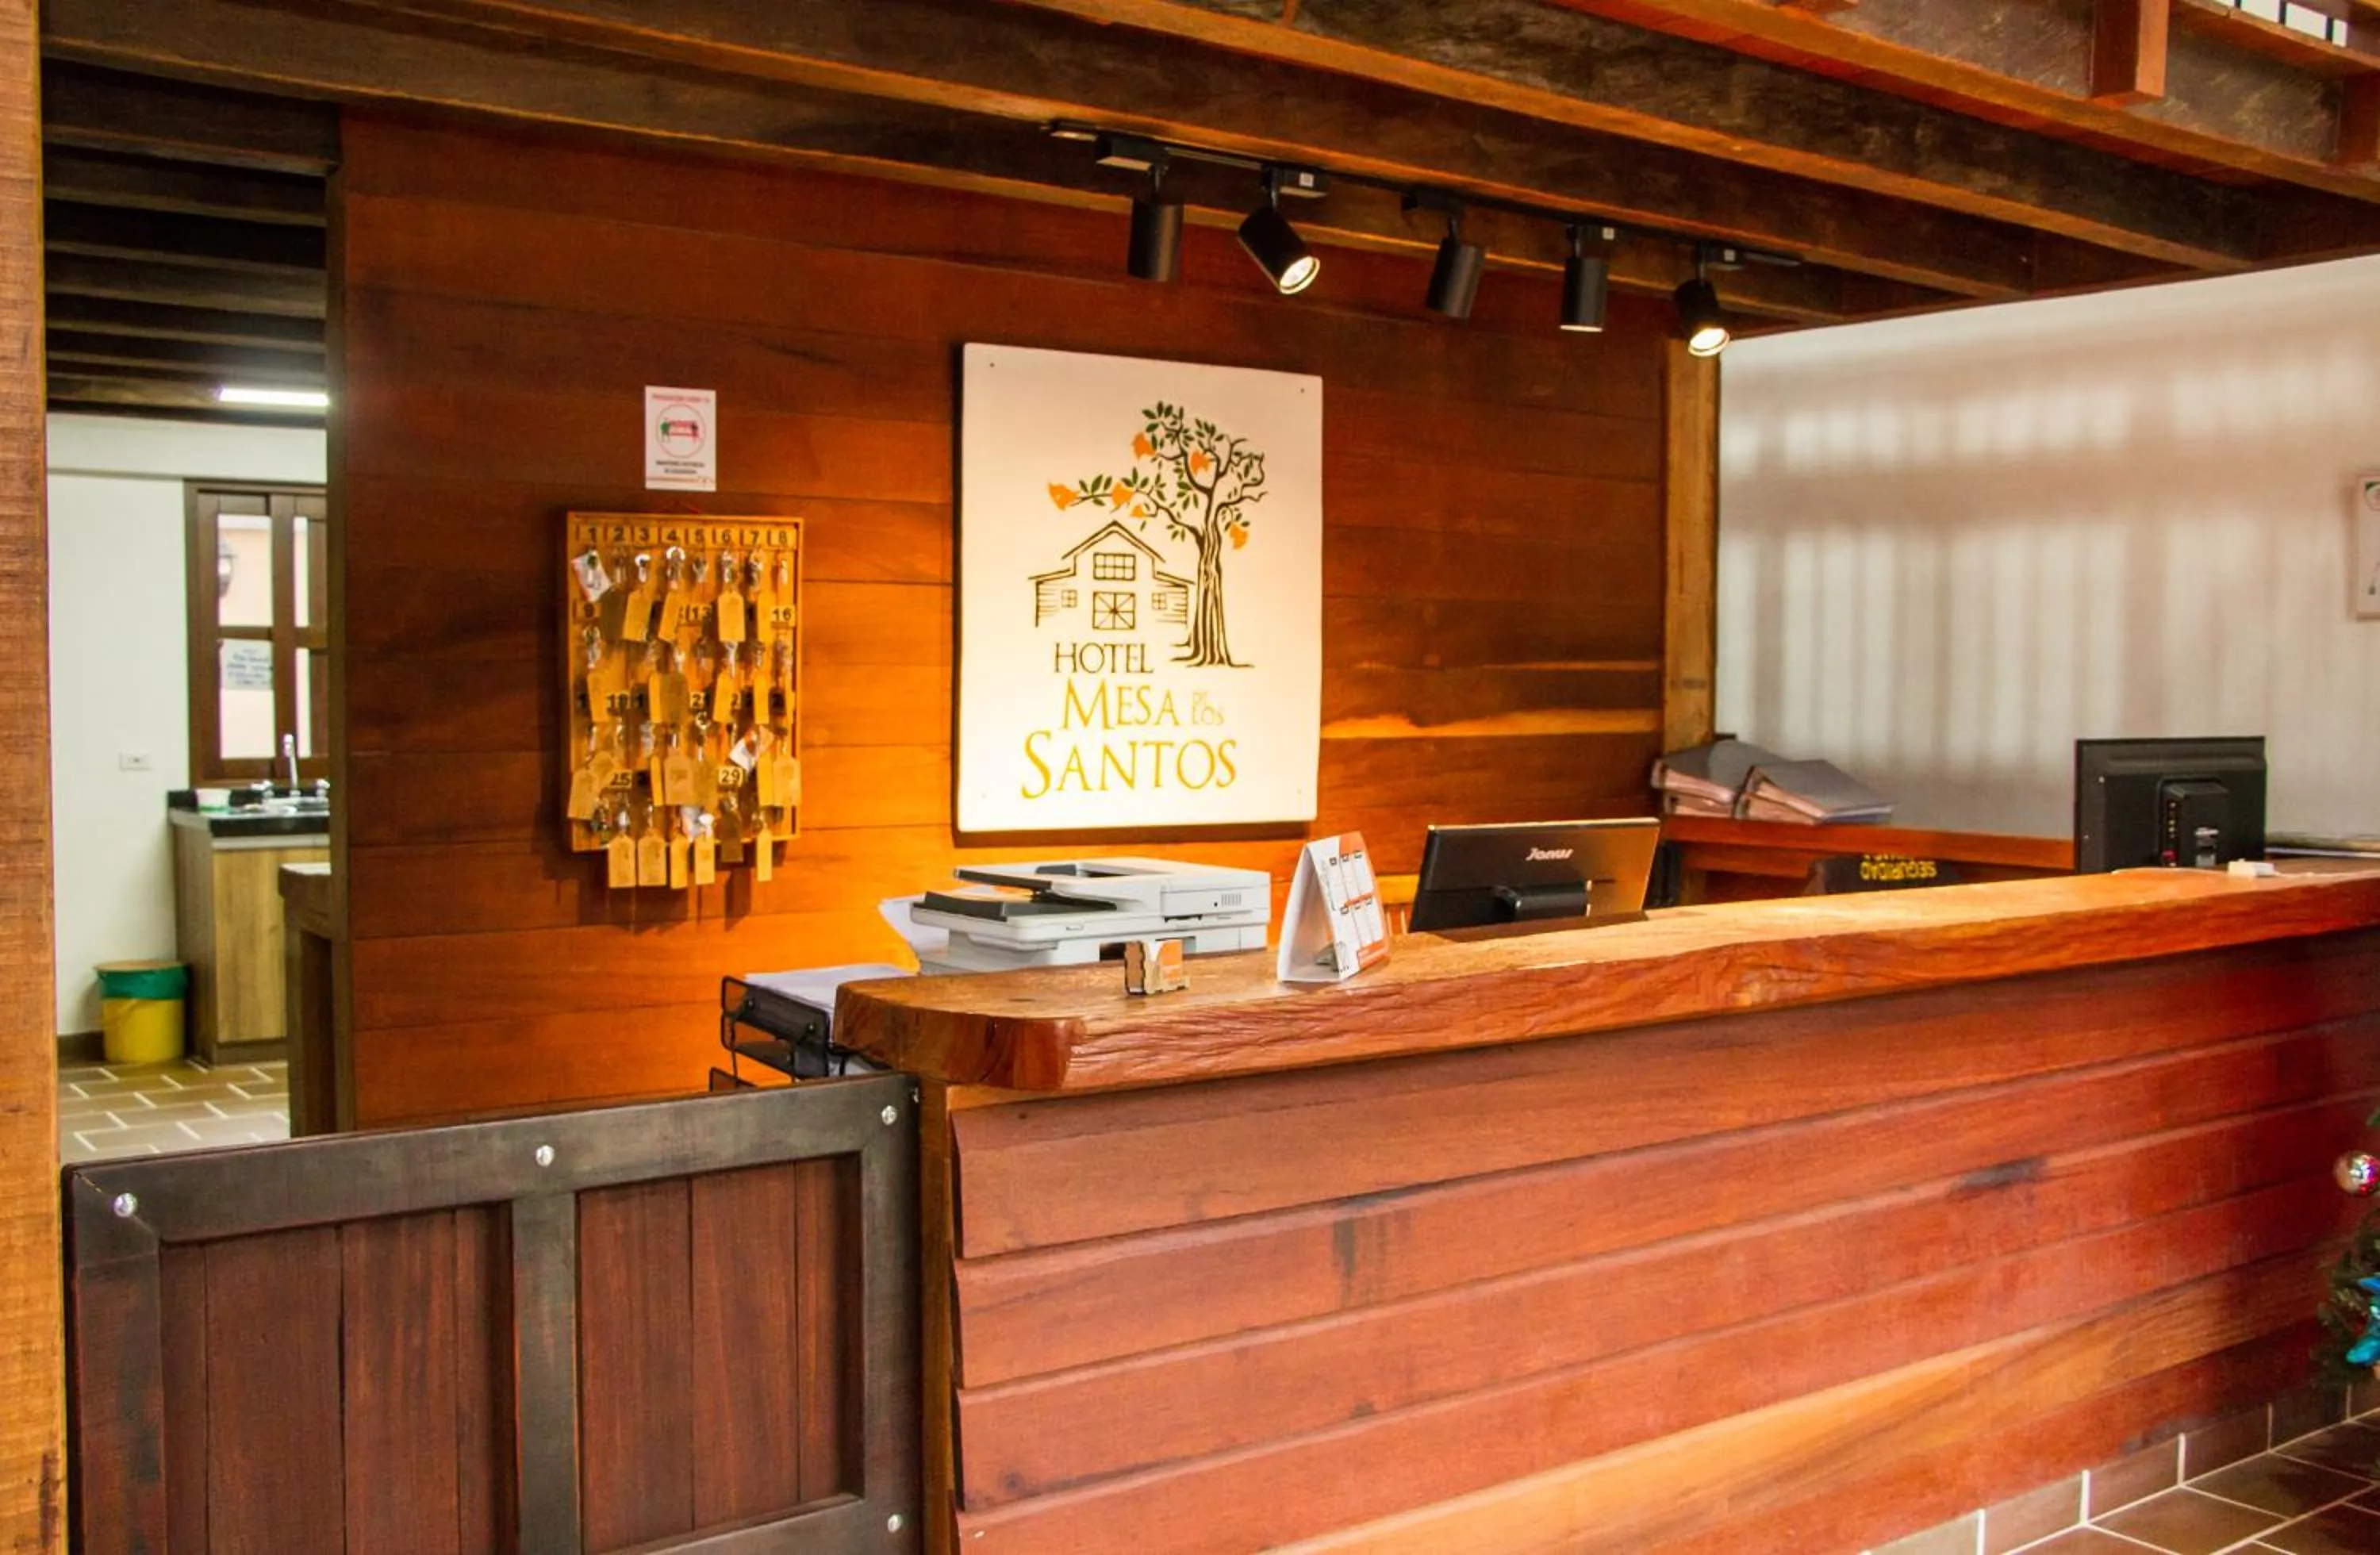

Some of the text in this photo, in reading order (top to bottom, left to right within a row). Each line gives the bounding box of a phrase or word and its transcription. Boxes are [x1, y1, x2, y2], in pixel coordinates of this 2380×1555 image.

[588, 525, 787, 547] 1 2 3 4 5 6 7 8
[771, 608, 792, 621] 16
[1054, 643, 1154, 674] HOTEL
[1061, 678, 1180, 730] MESA
[1192, 705, 1224, 726] LOS
[1021, 730, 1238, 801] SANTOS
[721, 770, 741, 784] 29
